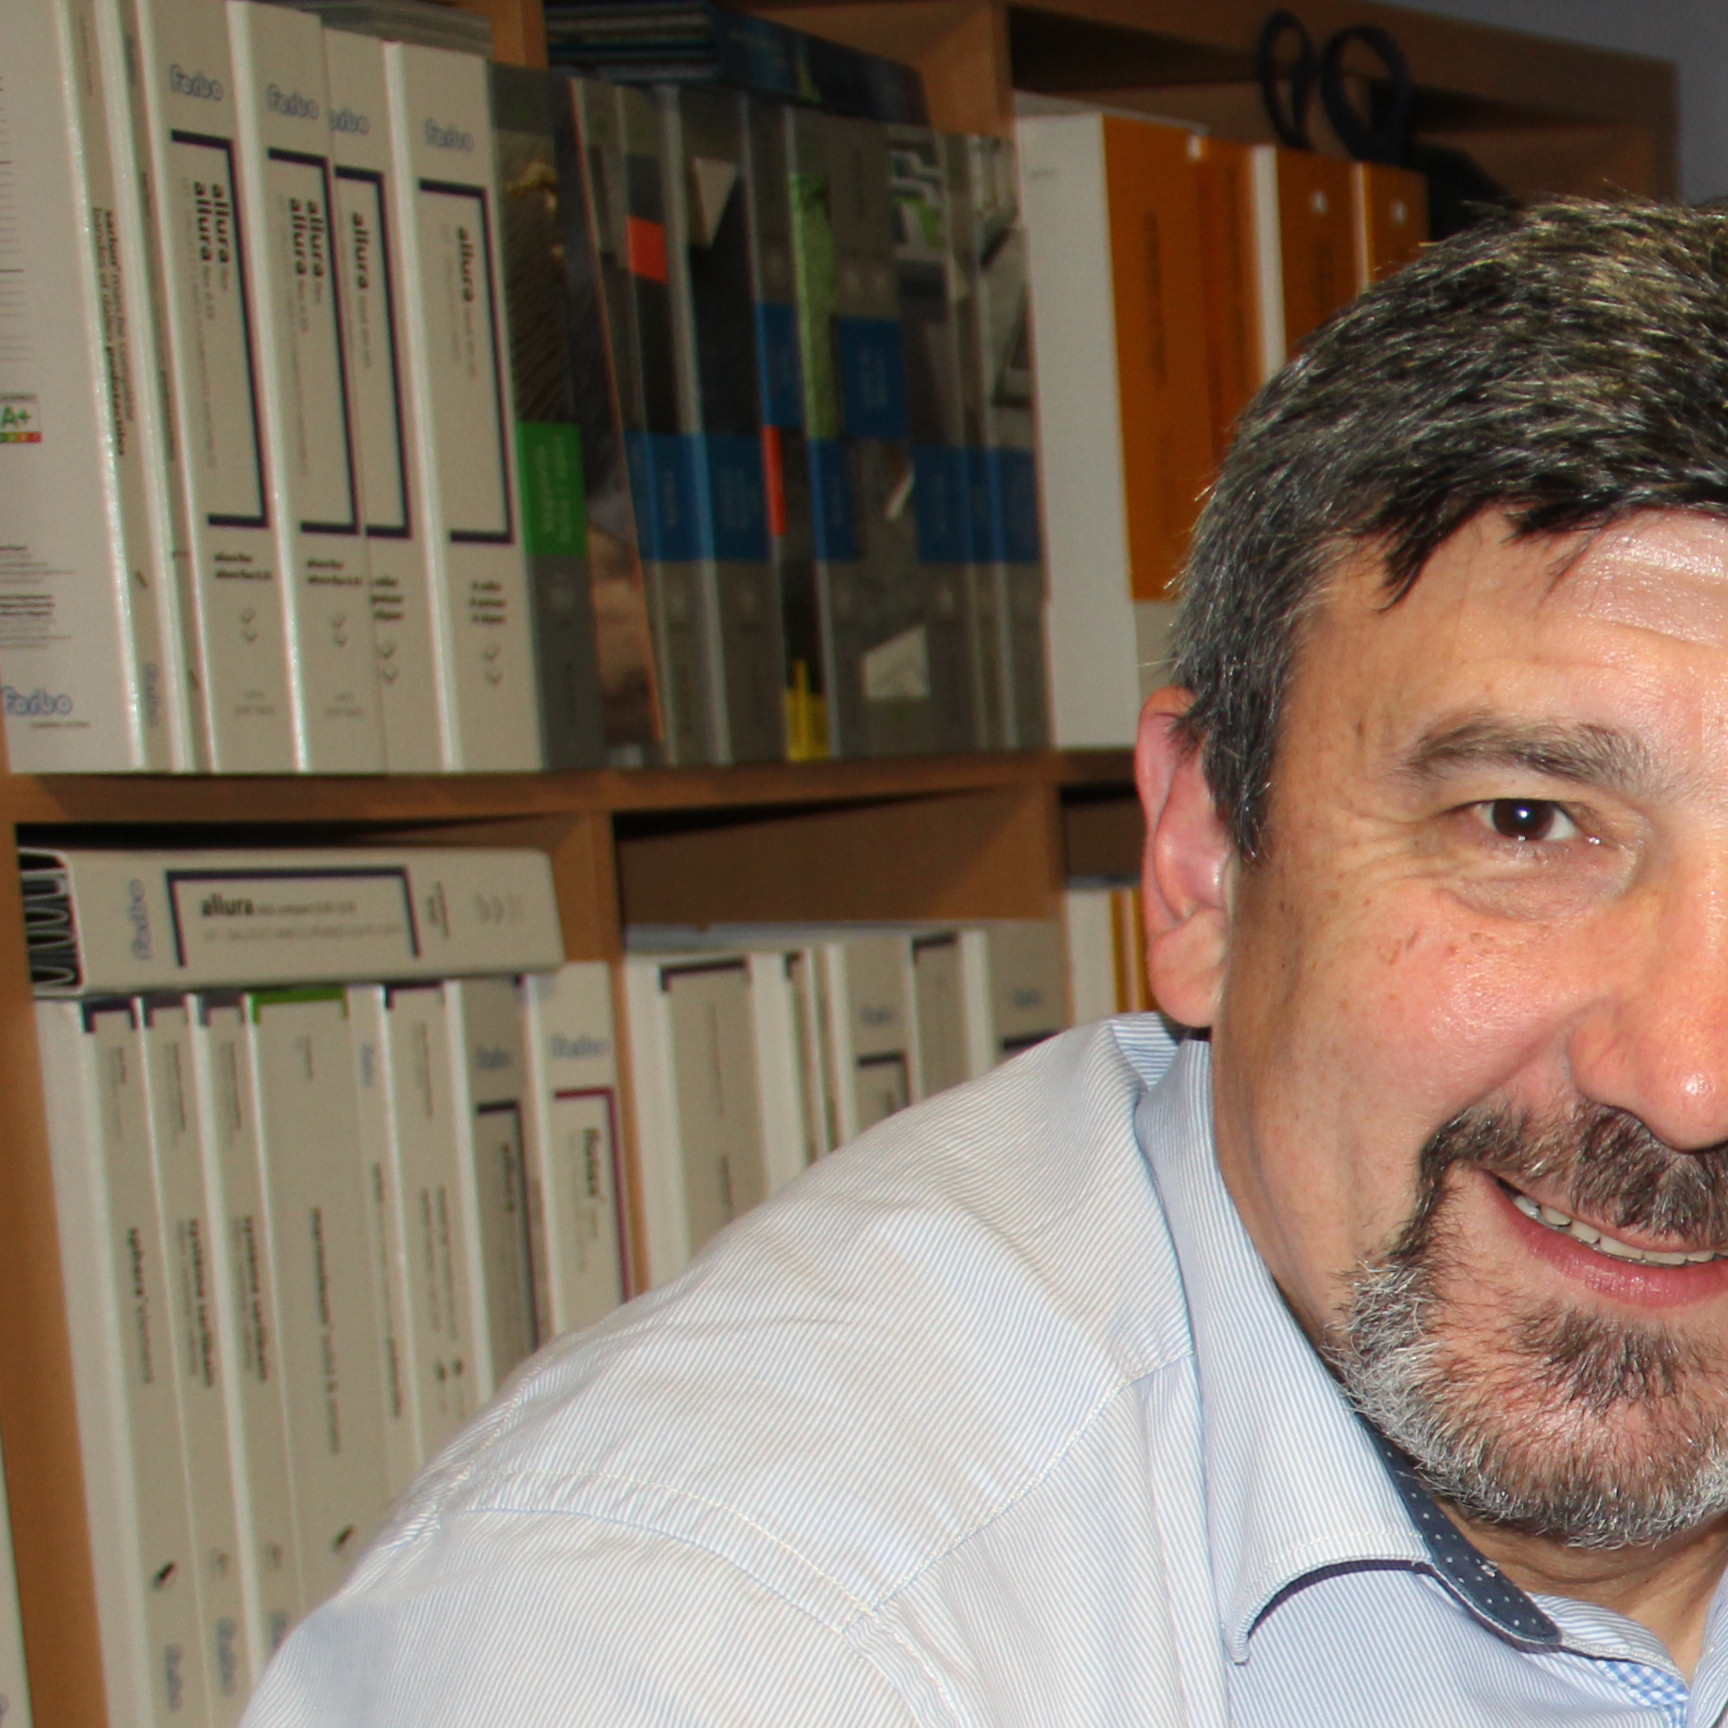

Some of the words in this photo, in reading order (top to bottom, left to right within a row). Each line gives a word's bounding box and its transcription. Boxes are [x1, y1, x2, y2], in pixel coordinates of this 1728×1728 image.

[194, 181, 213, 262] allura
[212, 183, 230, 264] allura
[289, 197, 308, 276] allura
[307, 200, 326, 277] allura
[351, 211, 371, 289] allura
[456, 226, 477, 303] allura
[0, 684, 75, 717] Forbo
[201, 892, 255, 917] allura
